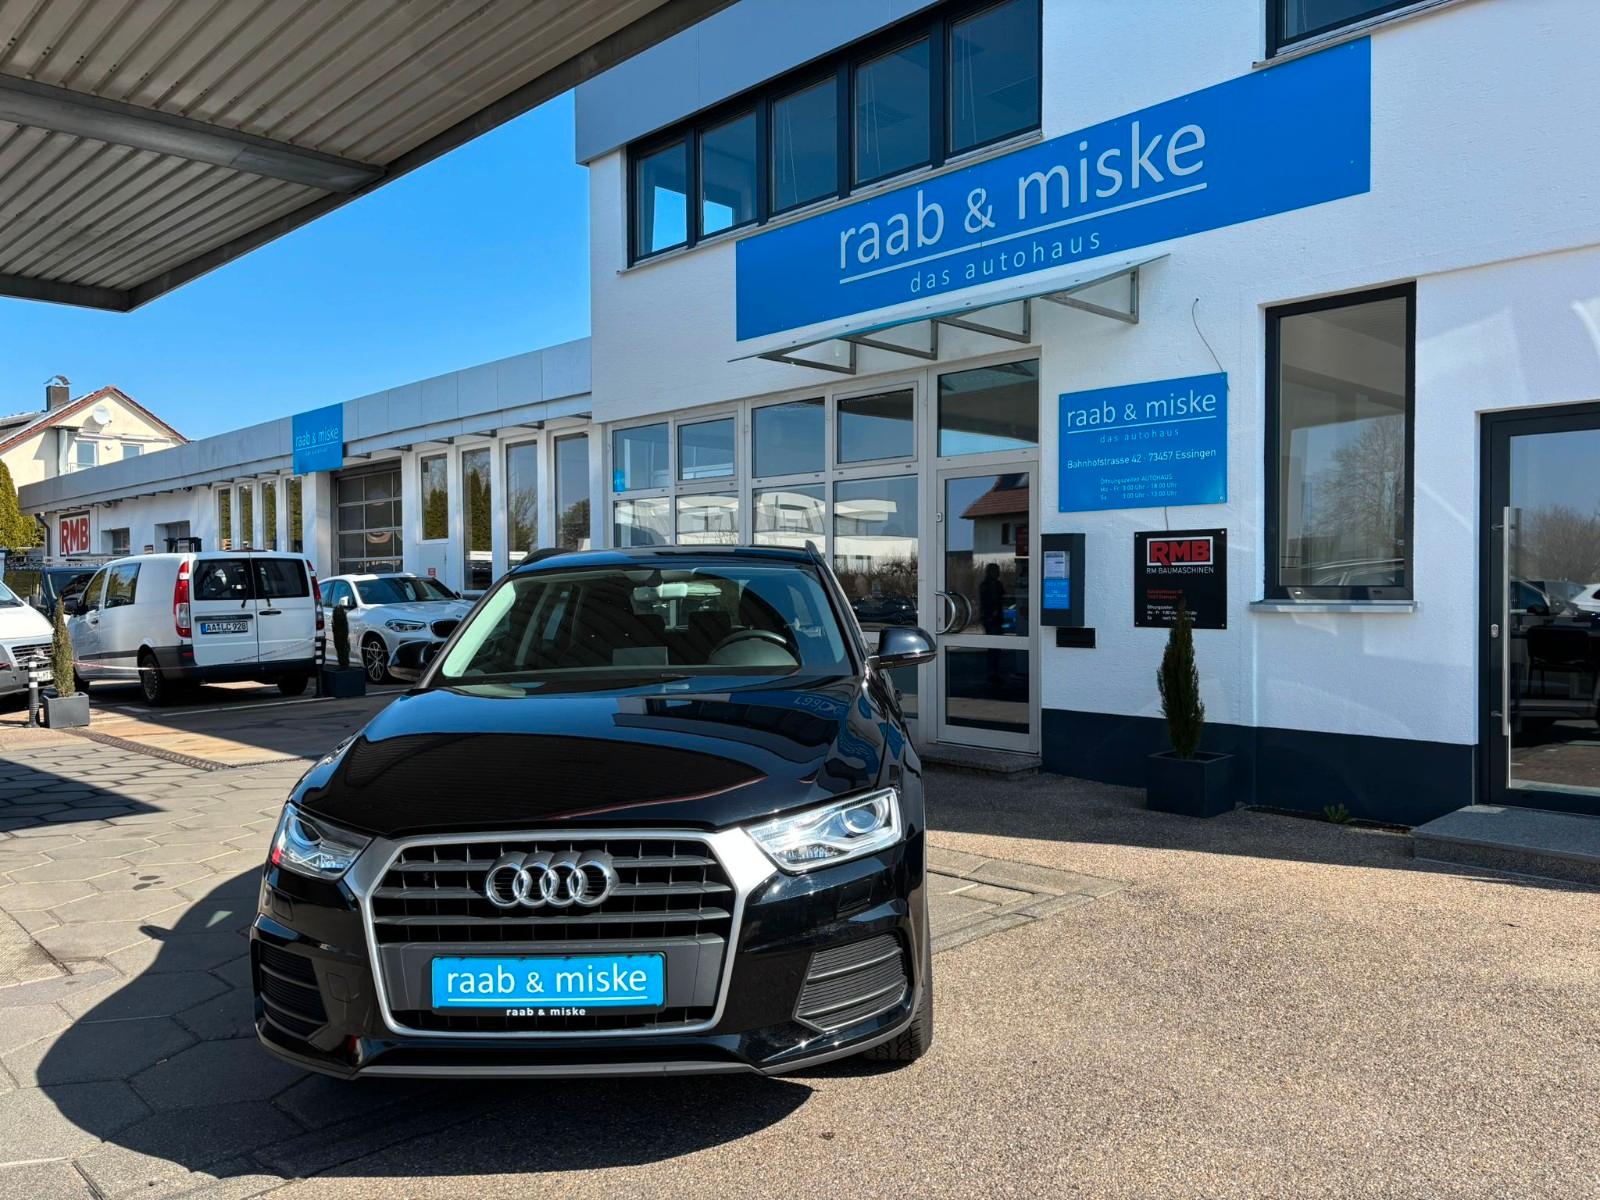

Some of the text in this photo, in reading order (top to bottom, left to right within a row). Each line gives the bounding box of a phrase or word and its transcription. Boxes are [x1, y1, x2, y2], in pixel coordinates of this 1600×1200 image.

[839, 121, 1206, 269] raab & miske
[910, 231, 1101, 294] das autohaus
[1067, 389, 1216, 427] raab & miske
[1100, 429, 1179, 444] das autohaus
[1067, 456, 1130, 469] Bahnhofstrasse
[1131, 453, 1142, 464] 42
[1148, 451, 1173, 463] 73457
[1175, 448, 1217, 461] Essingen
[61, 517, 89, 557] RMB
[1150, 540, 1210, 566] RMB
[1158, 566, 1214, 574] BAUMASCHINEN
[447, 962, 647, 994] raab & miske
[506, 1007, 586, 1016] raab & miske
